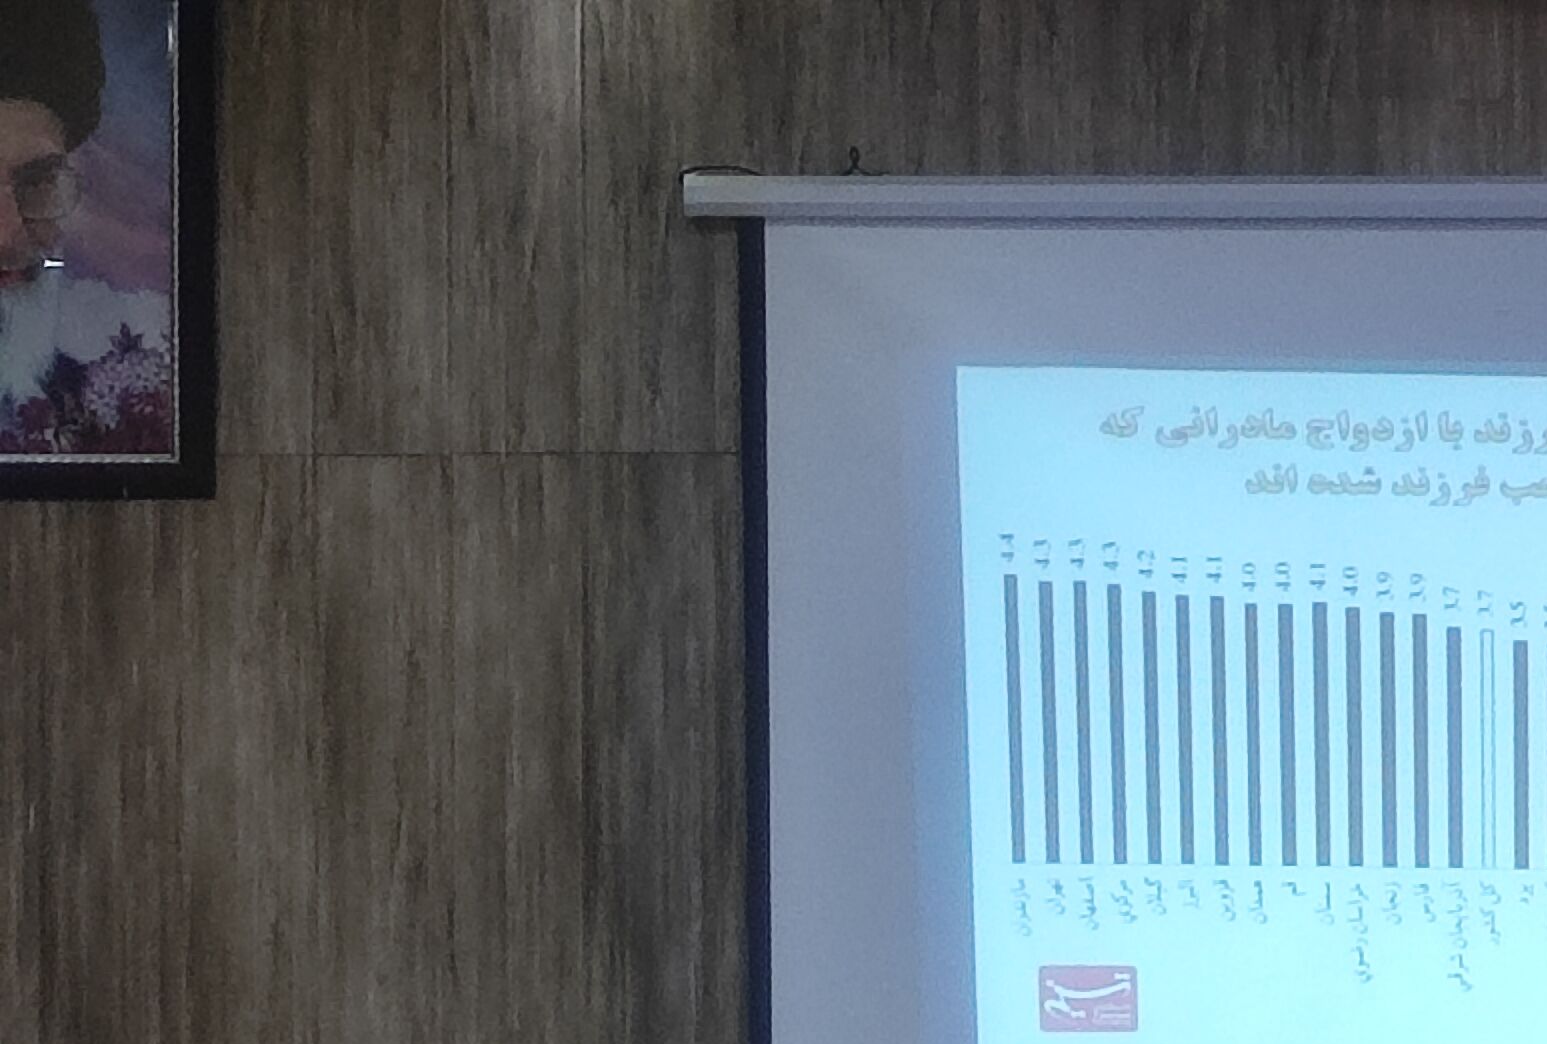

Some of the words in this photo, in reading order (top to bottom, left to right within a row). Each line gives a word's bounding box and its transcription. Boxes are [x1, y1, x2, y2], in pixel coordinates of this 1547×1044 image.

[1099, 406, 1145, 438] که
[1155, 406, 1297, 449] مادرانی
[1306, 409, 1428, 452] ازدواج
[1438, 411, 1463, 450] با
[1245, 463, 1298, 495] اند
[1307, 466, 1381, 495] شده
[1391, 465, 1491, 506] فرزند
